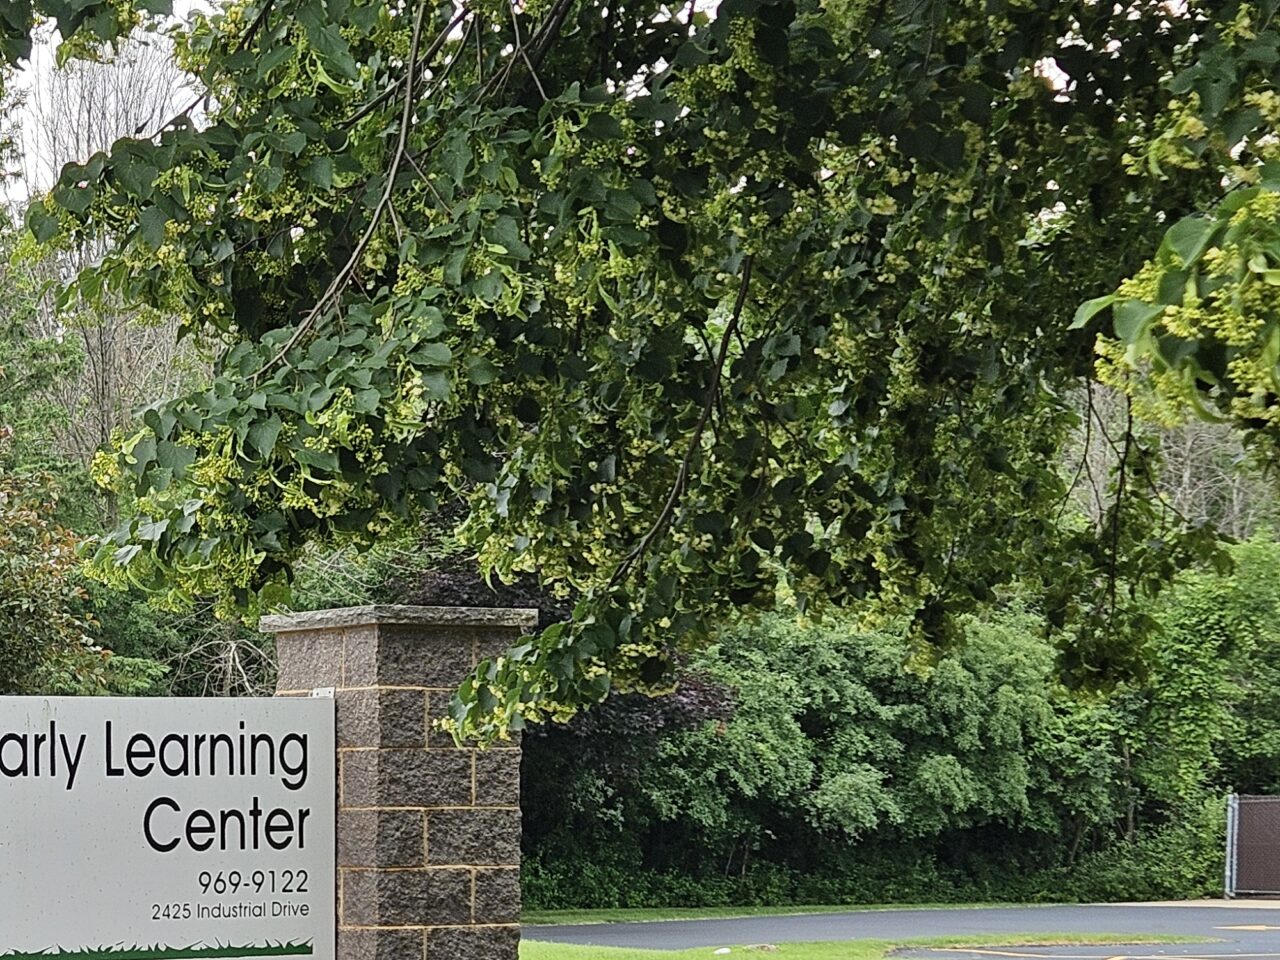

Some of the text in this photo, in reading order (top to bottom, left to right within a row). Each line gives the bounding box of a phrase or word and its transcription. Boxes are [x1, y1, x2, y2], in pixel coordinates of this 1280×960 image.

[105, 720, 308, 791] Learning
[143, 796, 310, 853] Center
[198, 869, 308, 895] 969-9122
[151, 901, 310, 920] 2425 Industrial Drive
